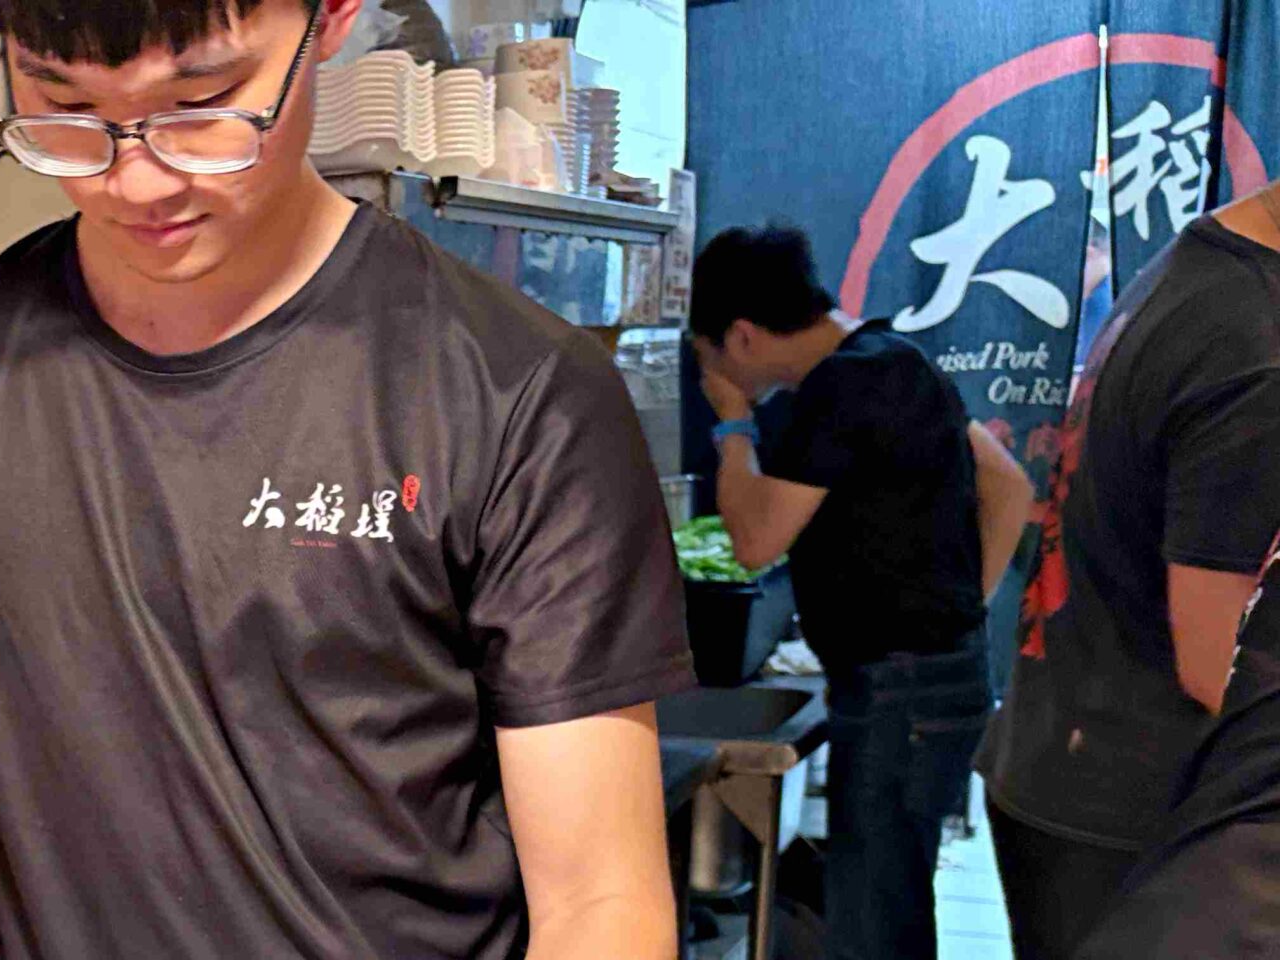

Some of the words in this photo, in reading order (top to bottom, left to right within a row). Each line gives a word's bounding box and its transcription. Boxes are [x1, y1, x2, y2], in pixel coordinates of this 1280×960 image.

[993, 342, 1049, 370] Pork
[988, 375, 1026, 405] On
[242, 477, 398, 542] 大稻埕
